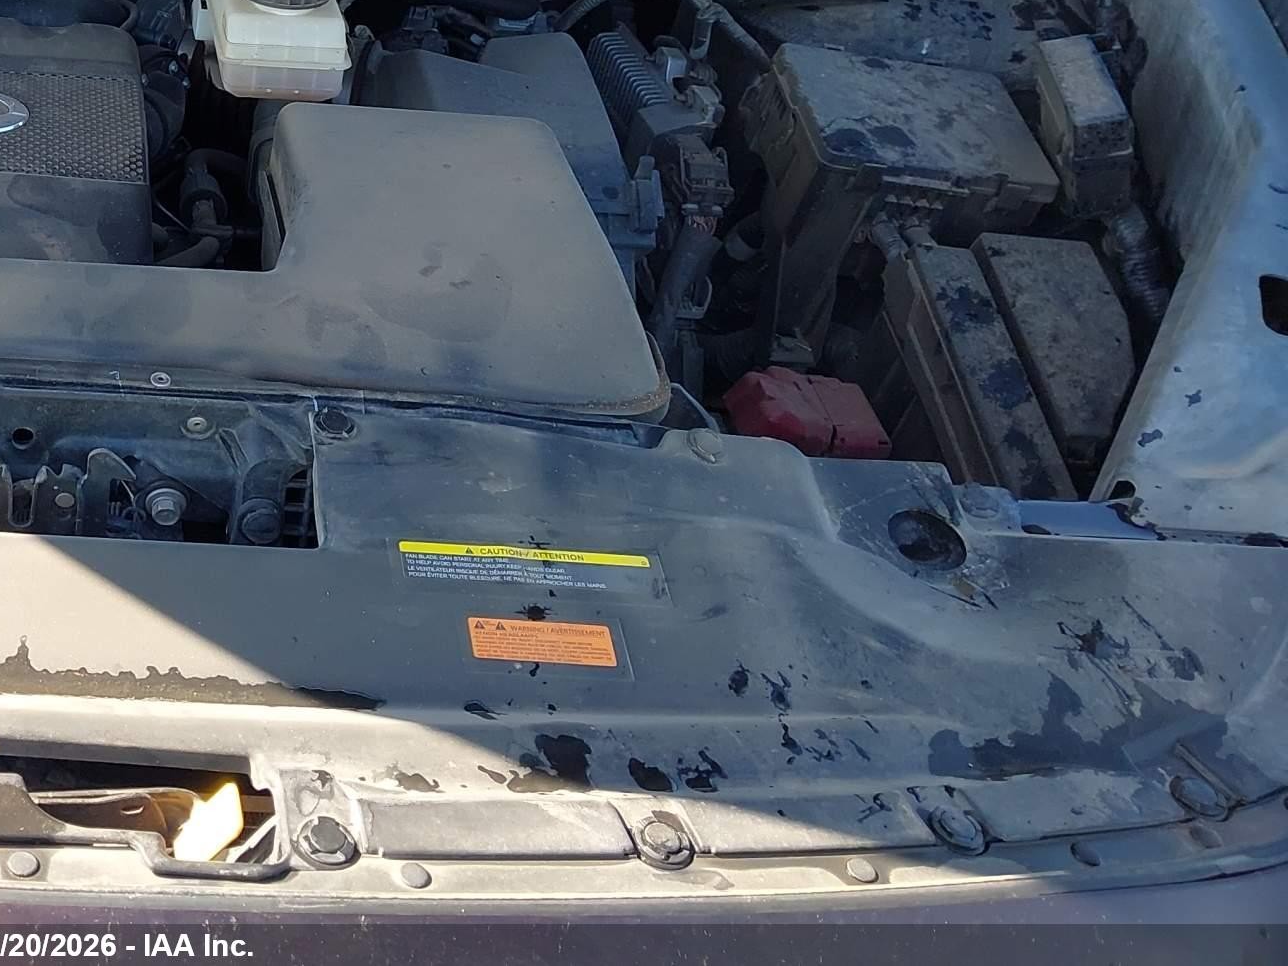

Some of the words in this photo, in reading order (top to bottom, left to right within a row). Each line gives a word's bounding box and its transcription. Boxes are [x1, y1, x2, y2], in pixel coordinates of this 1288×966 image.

[480, 548, 522, 557] CAUTION
[533, 551, 585, 562] ATTENTION
[535, 578, 573, 586] APPROCHER
[510, 624, 544, 634] WARNING
[550, 627, 606, 637] AVERTISSEMENT
